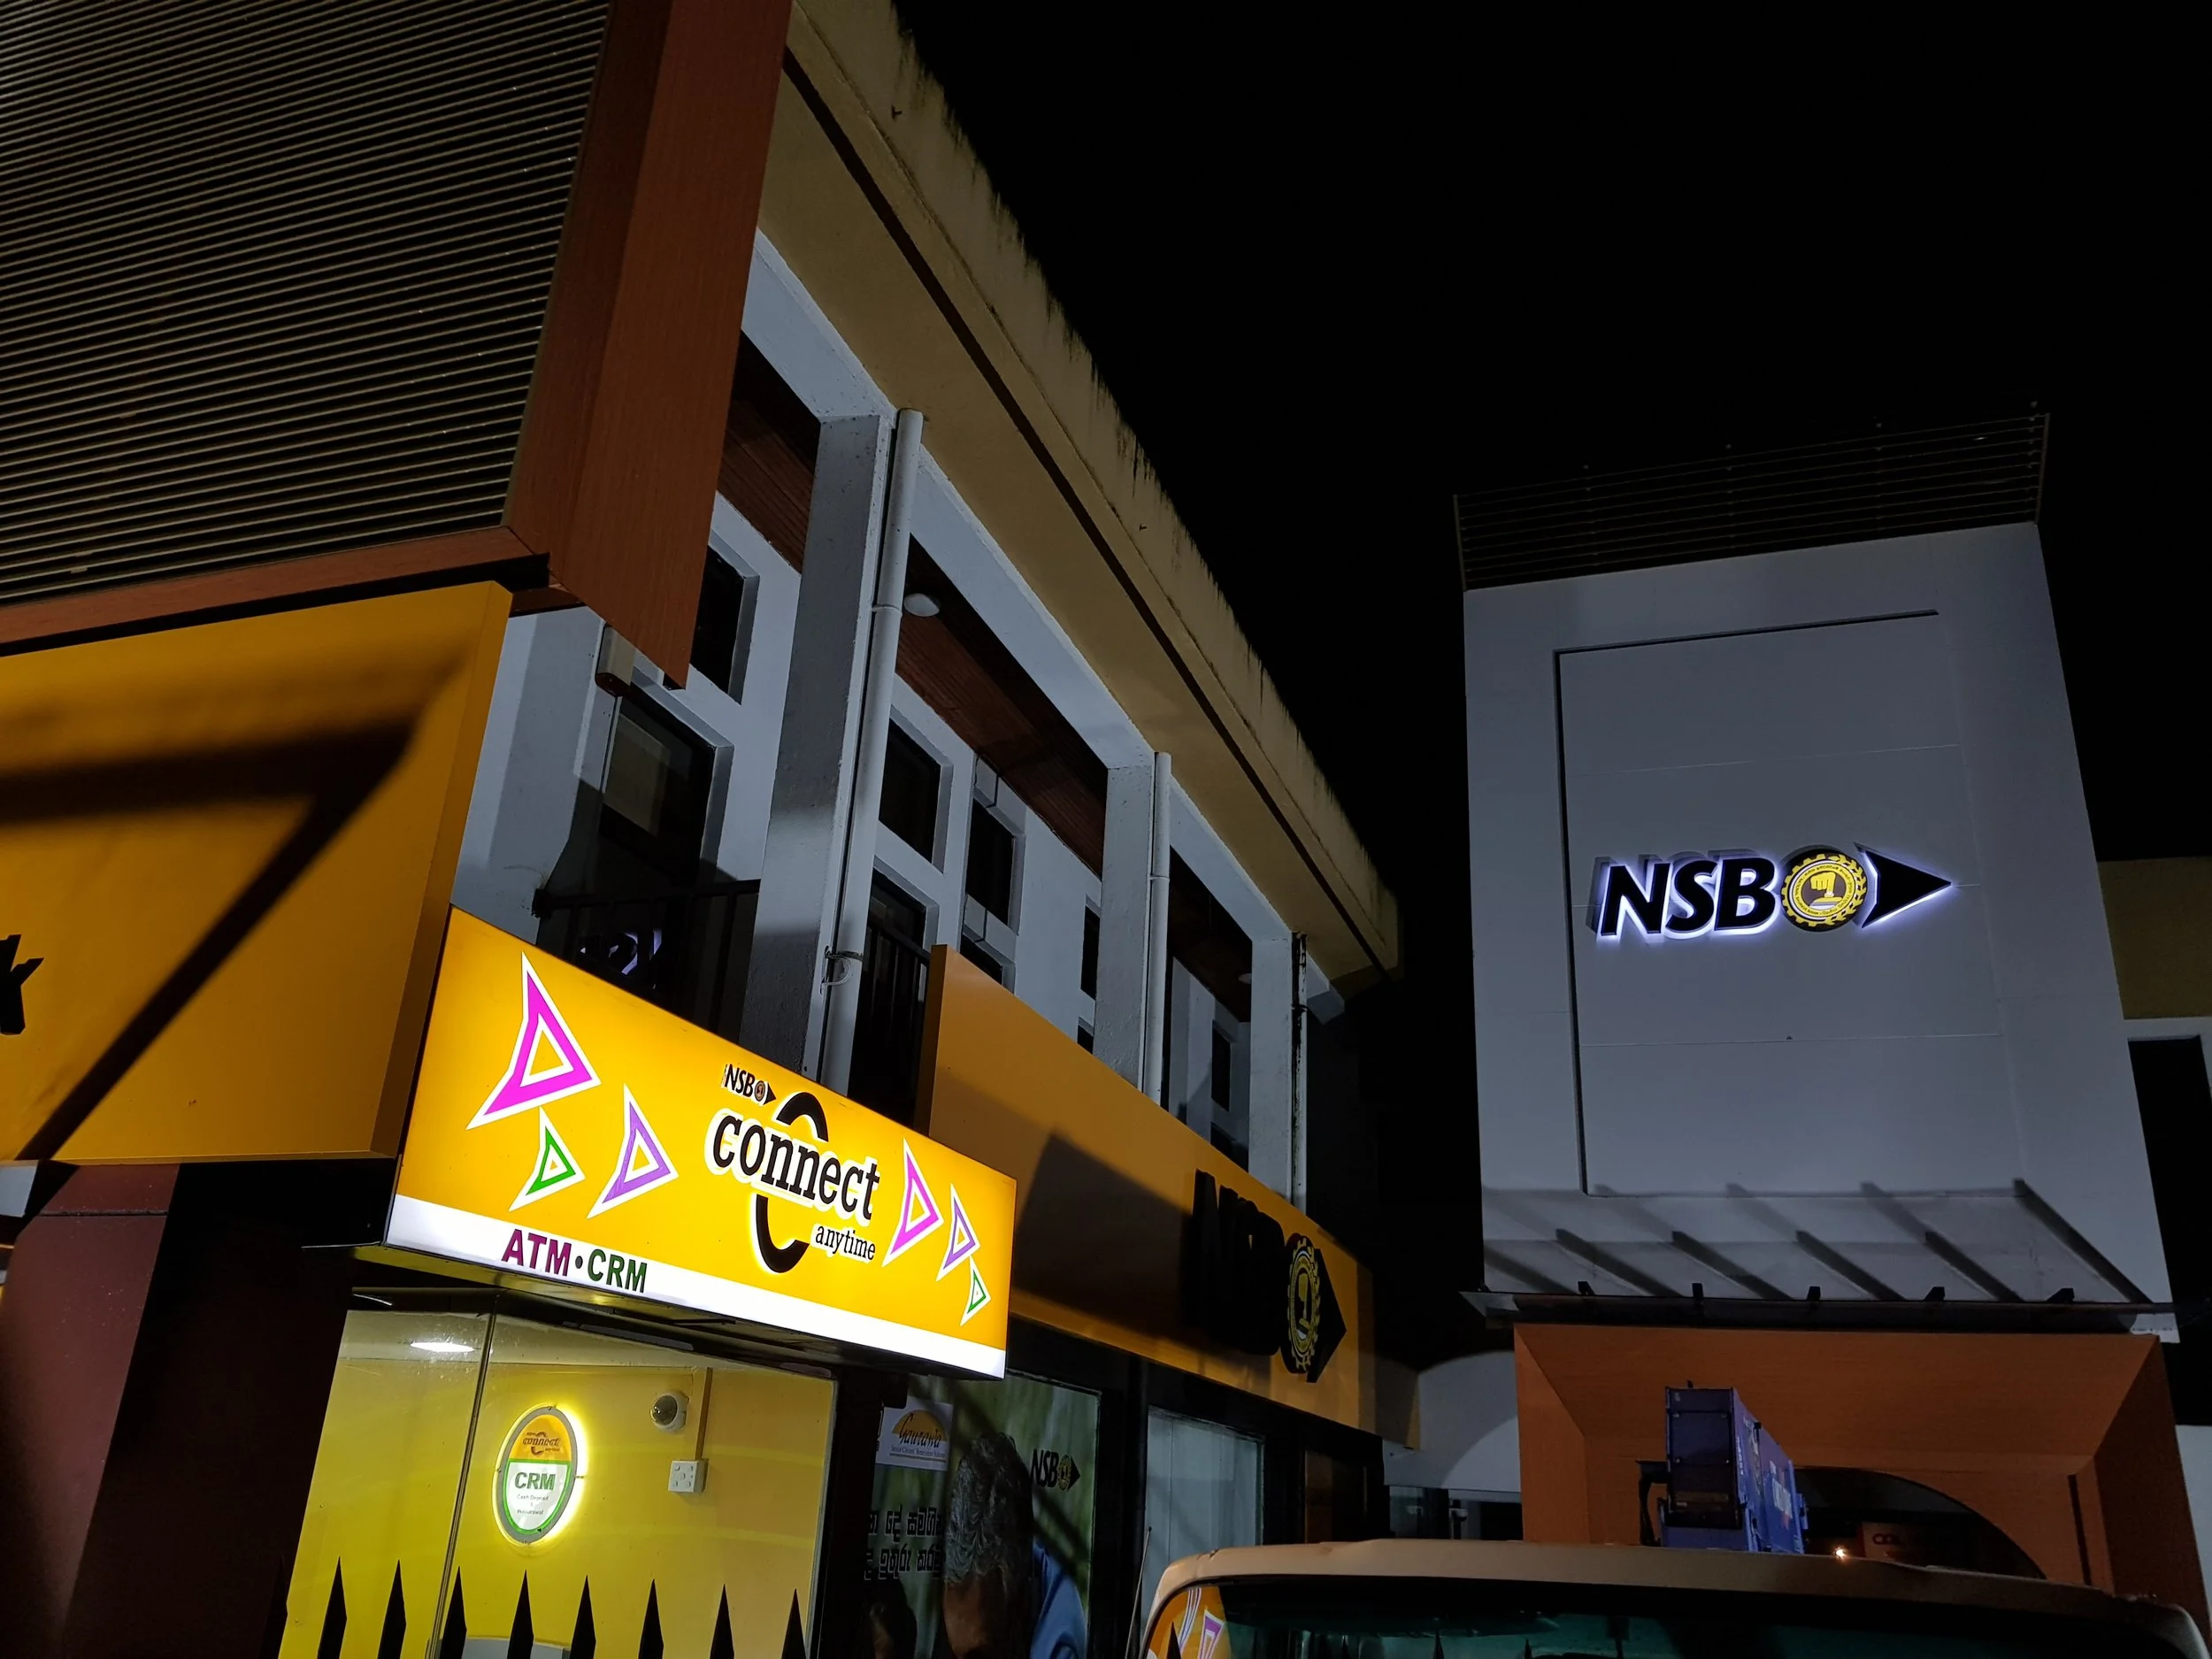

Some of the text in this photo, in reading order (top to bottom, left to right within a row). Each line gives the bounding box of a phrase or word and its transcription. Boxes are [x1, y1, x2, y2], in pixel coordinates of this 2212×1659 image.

[1601, 857, 1776, 936] NSB
[725, 1063, 756, 1097] NSB
[711, 1114, 881, 1220] connect
[501, 1228, 649, 1294] ATM CRM
[814, 1224, 877, 1261] anytime
[514, 1471, 556, 1491] CRM
[1030, 1448, 1059, 1488] NSB
